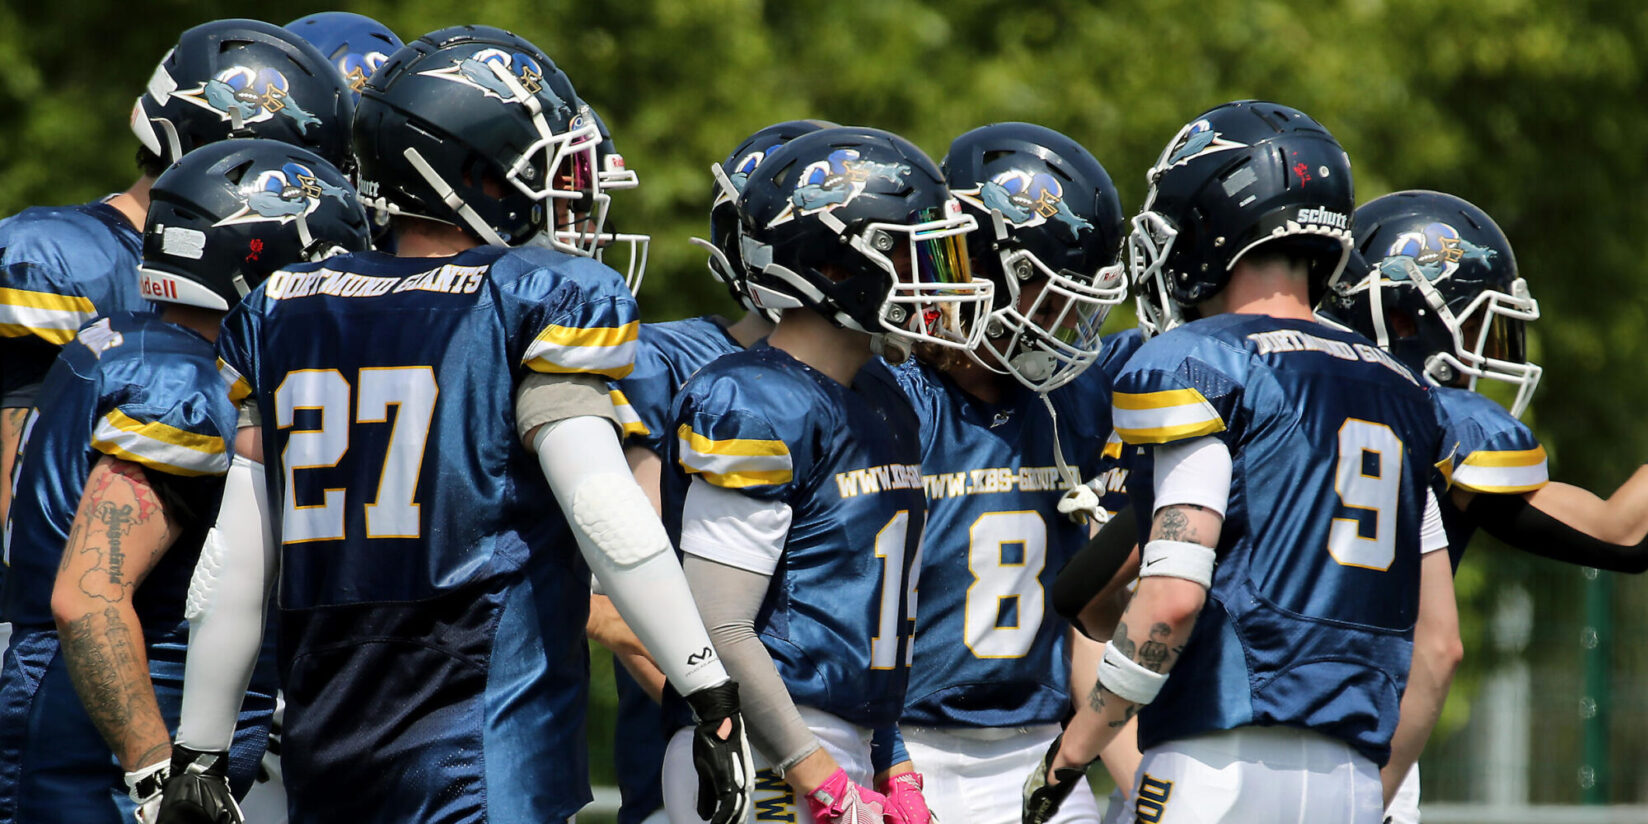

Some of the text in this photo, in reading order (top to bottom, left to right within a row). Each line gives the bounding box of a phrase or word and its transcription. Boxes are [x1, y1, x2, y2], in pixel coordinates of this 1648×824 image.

[265, 264, 490, 300] DORTMUND GIANTS
[1297, 205, 1348, 229] schutt
[274, 365, 440, 545] 27
[1327, 416, 1403, 572] 9
[964, 510, 1047, 658] 8
